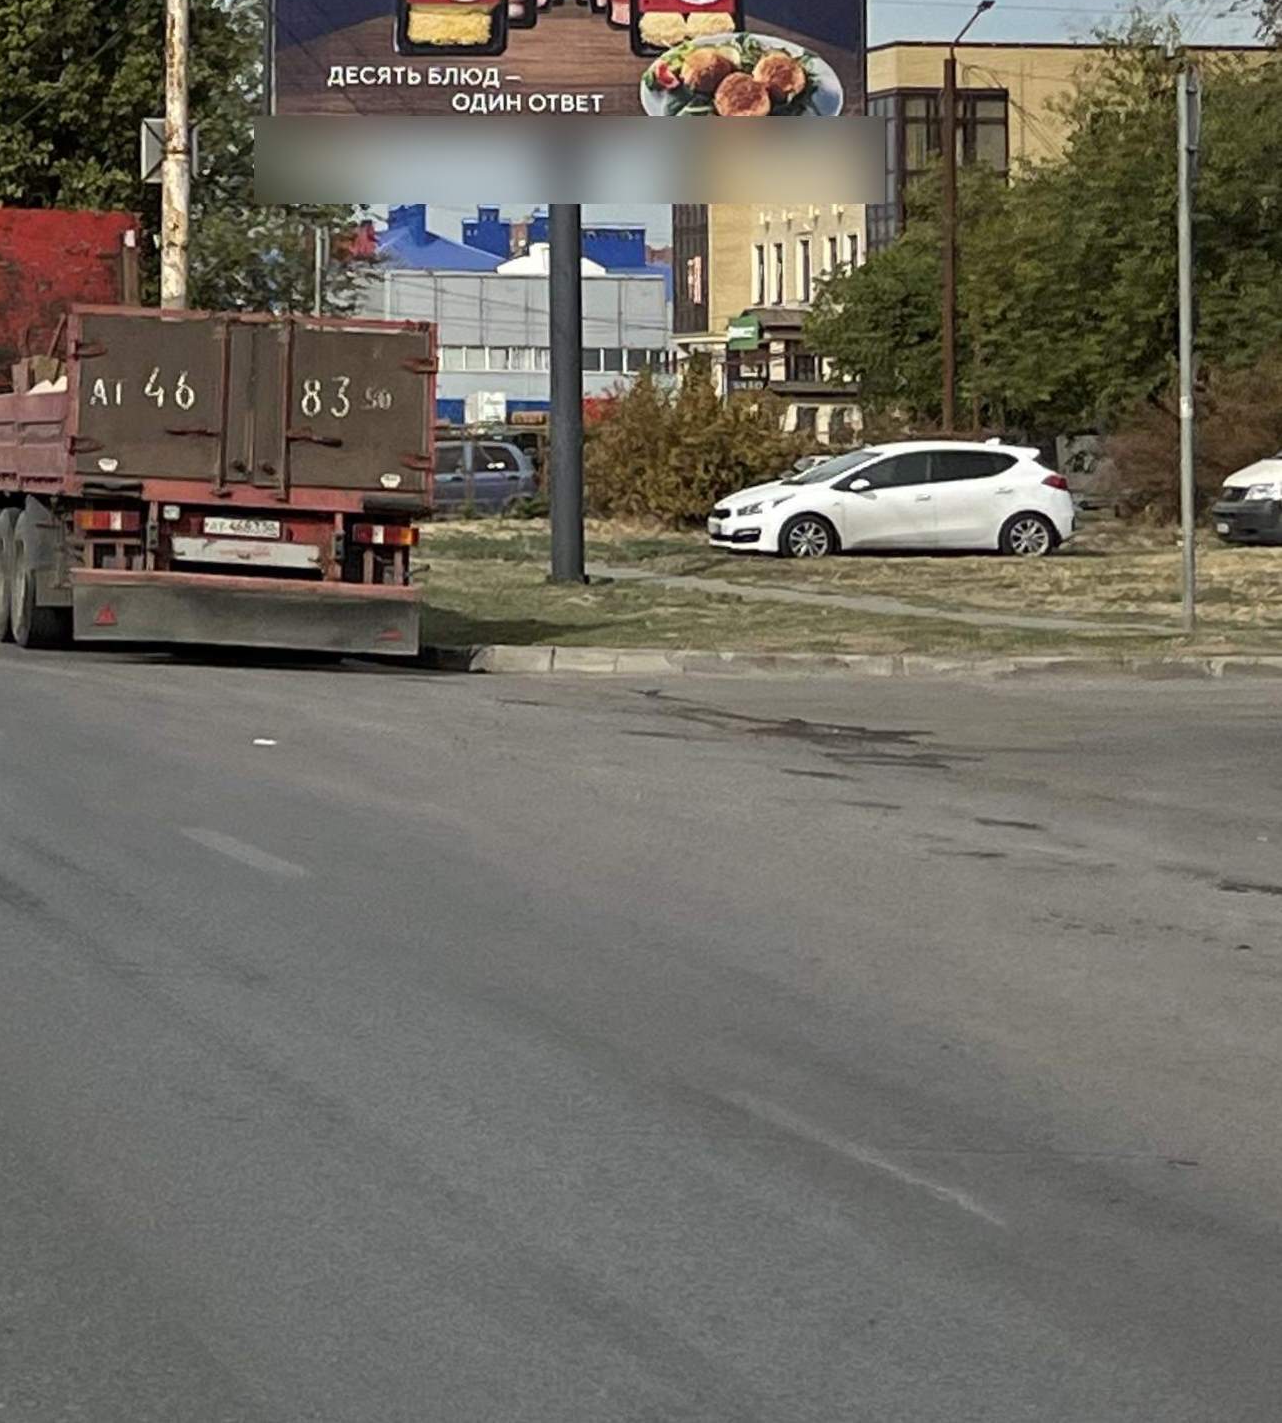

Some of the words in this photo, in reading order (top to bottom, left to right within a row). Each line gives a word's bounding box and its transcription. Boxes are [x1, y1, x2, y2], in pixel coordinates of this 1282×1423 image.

[327, 66, 422, 88] ДЕСЯТЬ
[427, 66, 501, 89] БЛЮД
[451, 93, 522, 114] ОДИН
[528, 93, 605, 113] ОТВЕТ
[143, 366, 196, 410] 46
[300, 376, 351, 417] 83
